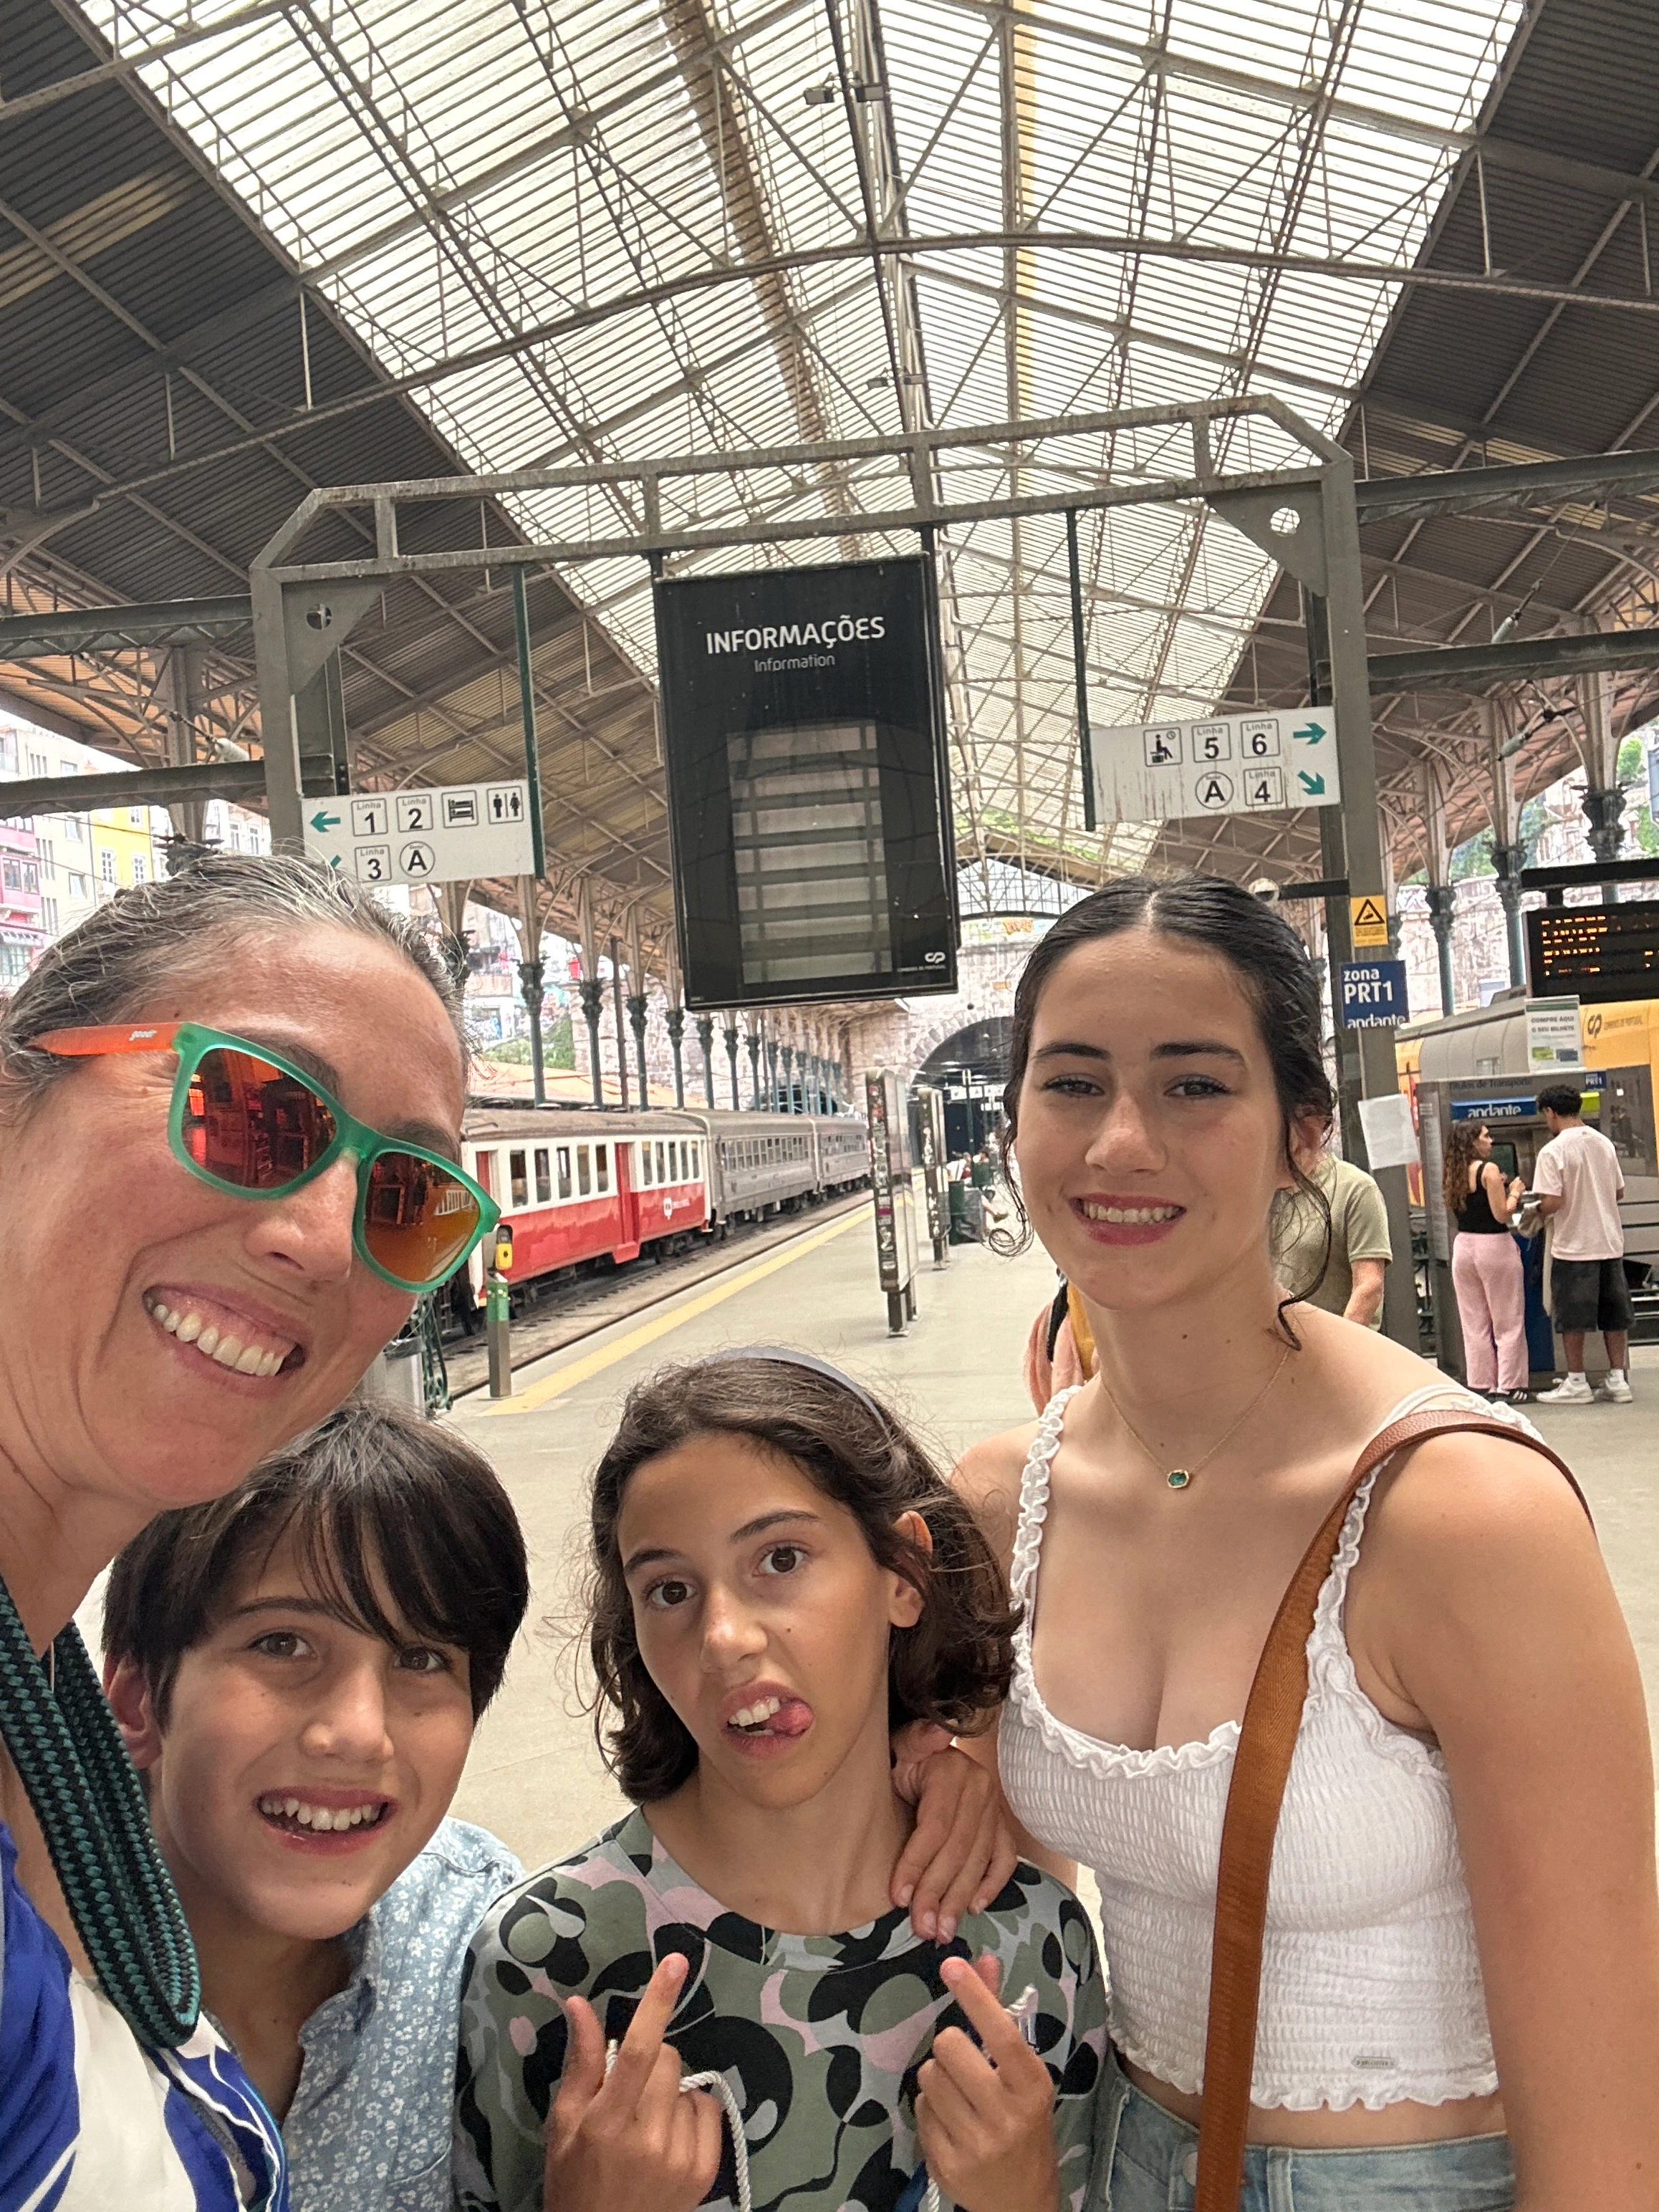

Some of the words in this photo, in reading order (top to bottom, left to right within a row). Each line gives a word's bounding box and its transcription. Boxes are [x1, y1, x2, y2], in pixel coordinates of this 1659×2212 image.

[706, 614, 886, 655] INFORMAÇÕES
[754, 653, 835, 673] Information
[1197, 726, 1223, 736] Linha
[1246, 722, 1273, 731] Linha
[1204, 736, 1219, 759] 5
[1252, 733, 1267, 756] 6
[1249, 770, 1276, 779] Linha
[1204, 780, 1226, 803] A
[1254, 780, 1271, 802] 4
[357, 802, 381, 810] Linha
[402, 797, 427, 807] Linha
[365, 812, 375, 833] 1
[408, 807, 423, 830] 2
[360, 847, 385, 857] Linha
[367, 858, 382, 880] 3
[407, 850, 428, 871] A
[1344, 968, 1380, 982] zona
[1344, 980, 1393, 1004] PRT1
[1468, 1103, 1522, 1119] andante
